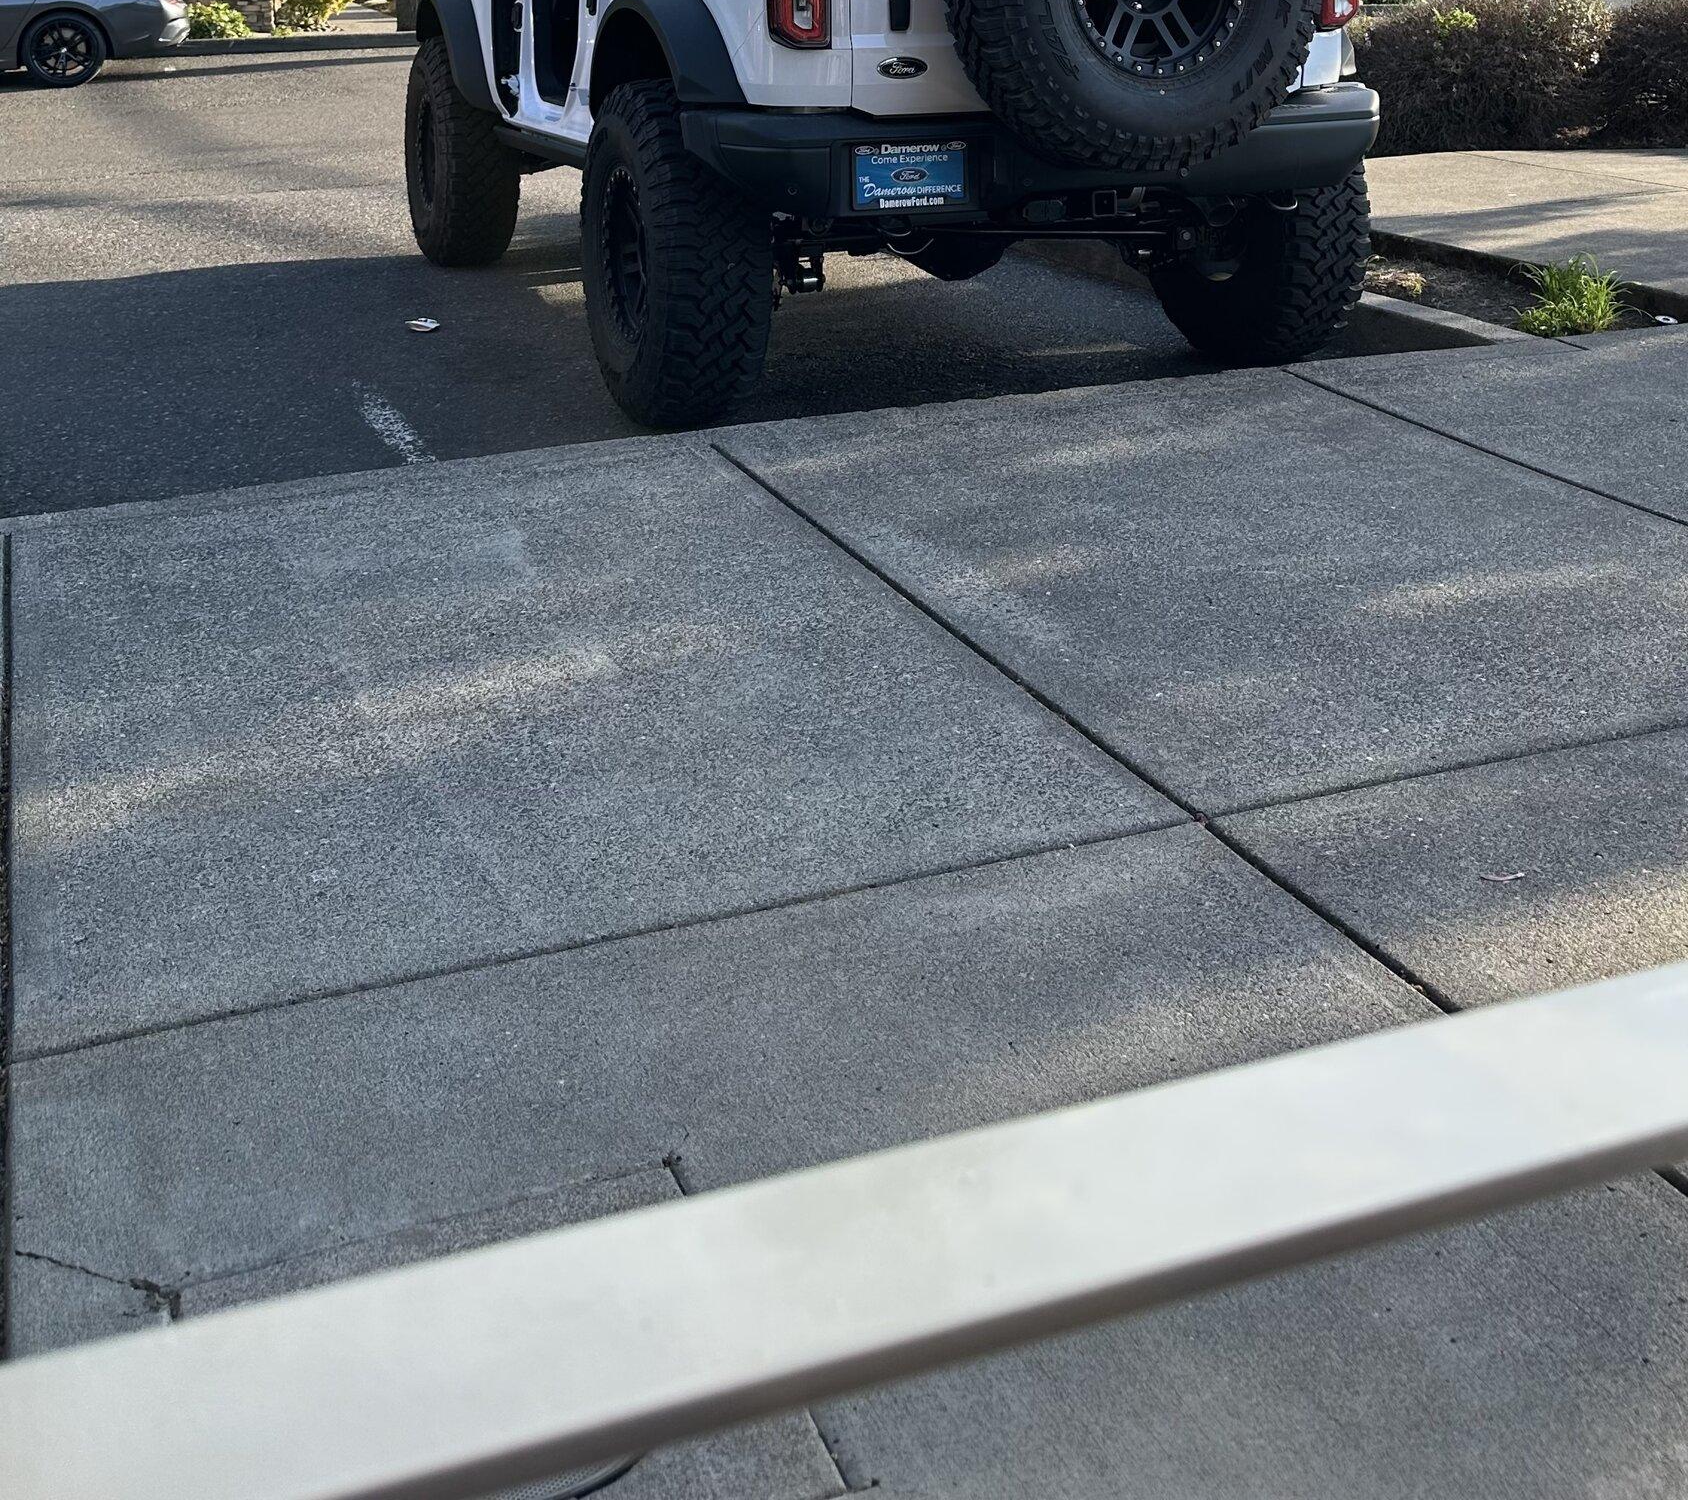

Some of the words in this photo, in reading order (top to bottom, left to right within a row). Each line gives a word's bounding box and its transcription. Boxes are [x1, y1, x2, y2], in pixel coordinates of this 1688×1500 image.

[889, 61, 916, 74] Ford
[881, 144, 940, 155] Damerow
[871, 156, 897, 165] Come
[900, 153, 948, 164] Experience
[863, 183, 916, 198] Damerow
[916, 184, 962, 194] DIFFERENCE
[880, 196, 945, 209] DamerowFord.com
